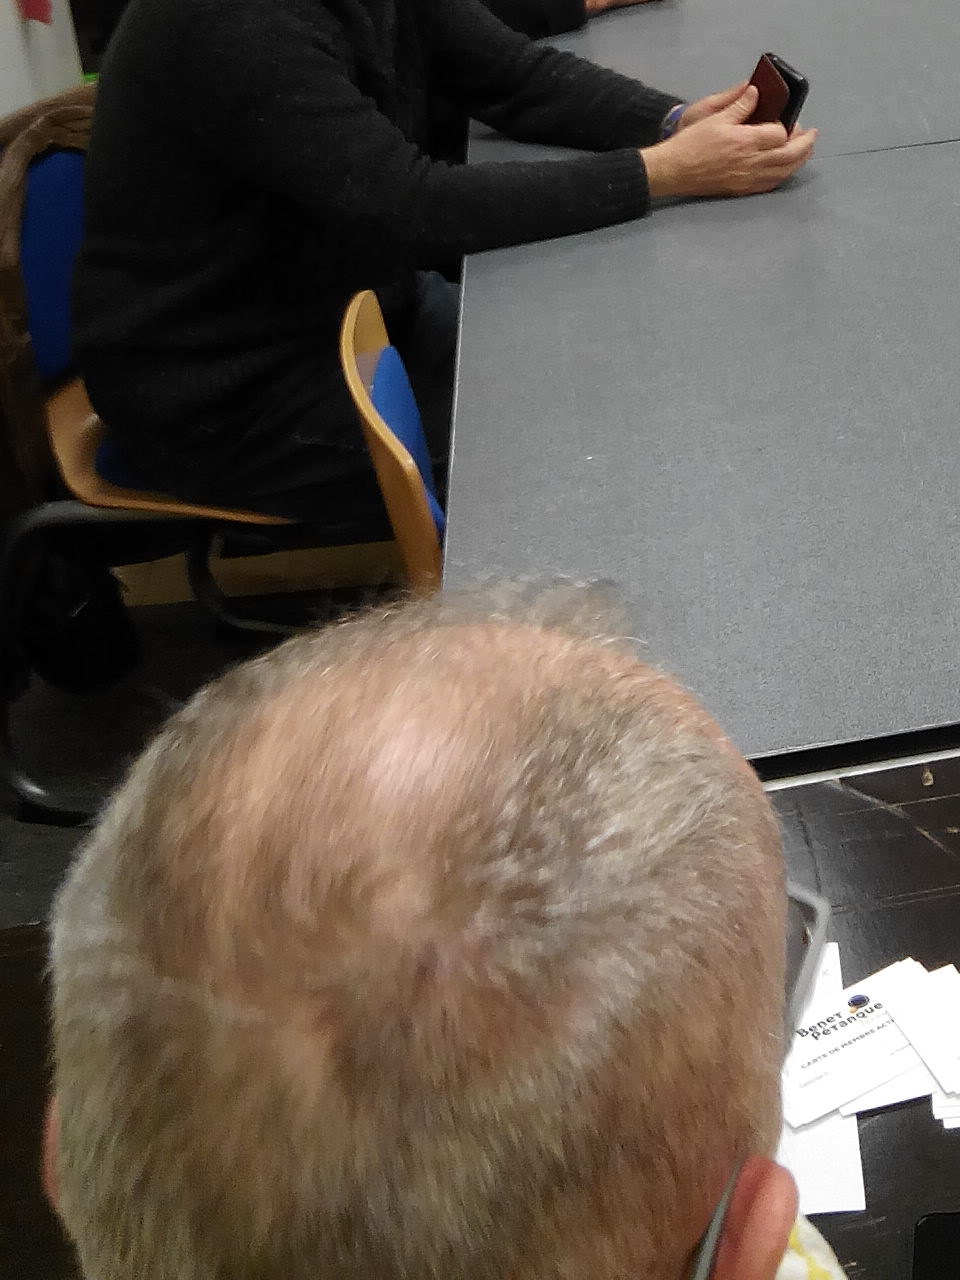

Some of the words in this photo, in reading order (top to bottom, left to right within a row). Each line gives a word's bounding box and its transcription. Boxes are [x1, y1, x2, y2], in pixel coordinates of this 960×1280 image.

[801, 1053, 828, 1069] CARTE
[828, 1046, 841, 1055] DE
[841, 1029, 876, 1048] MEMBRE
